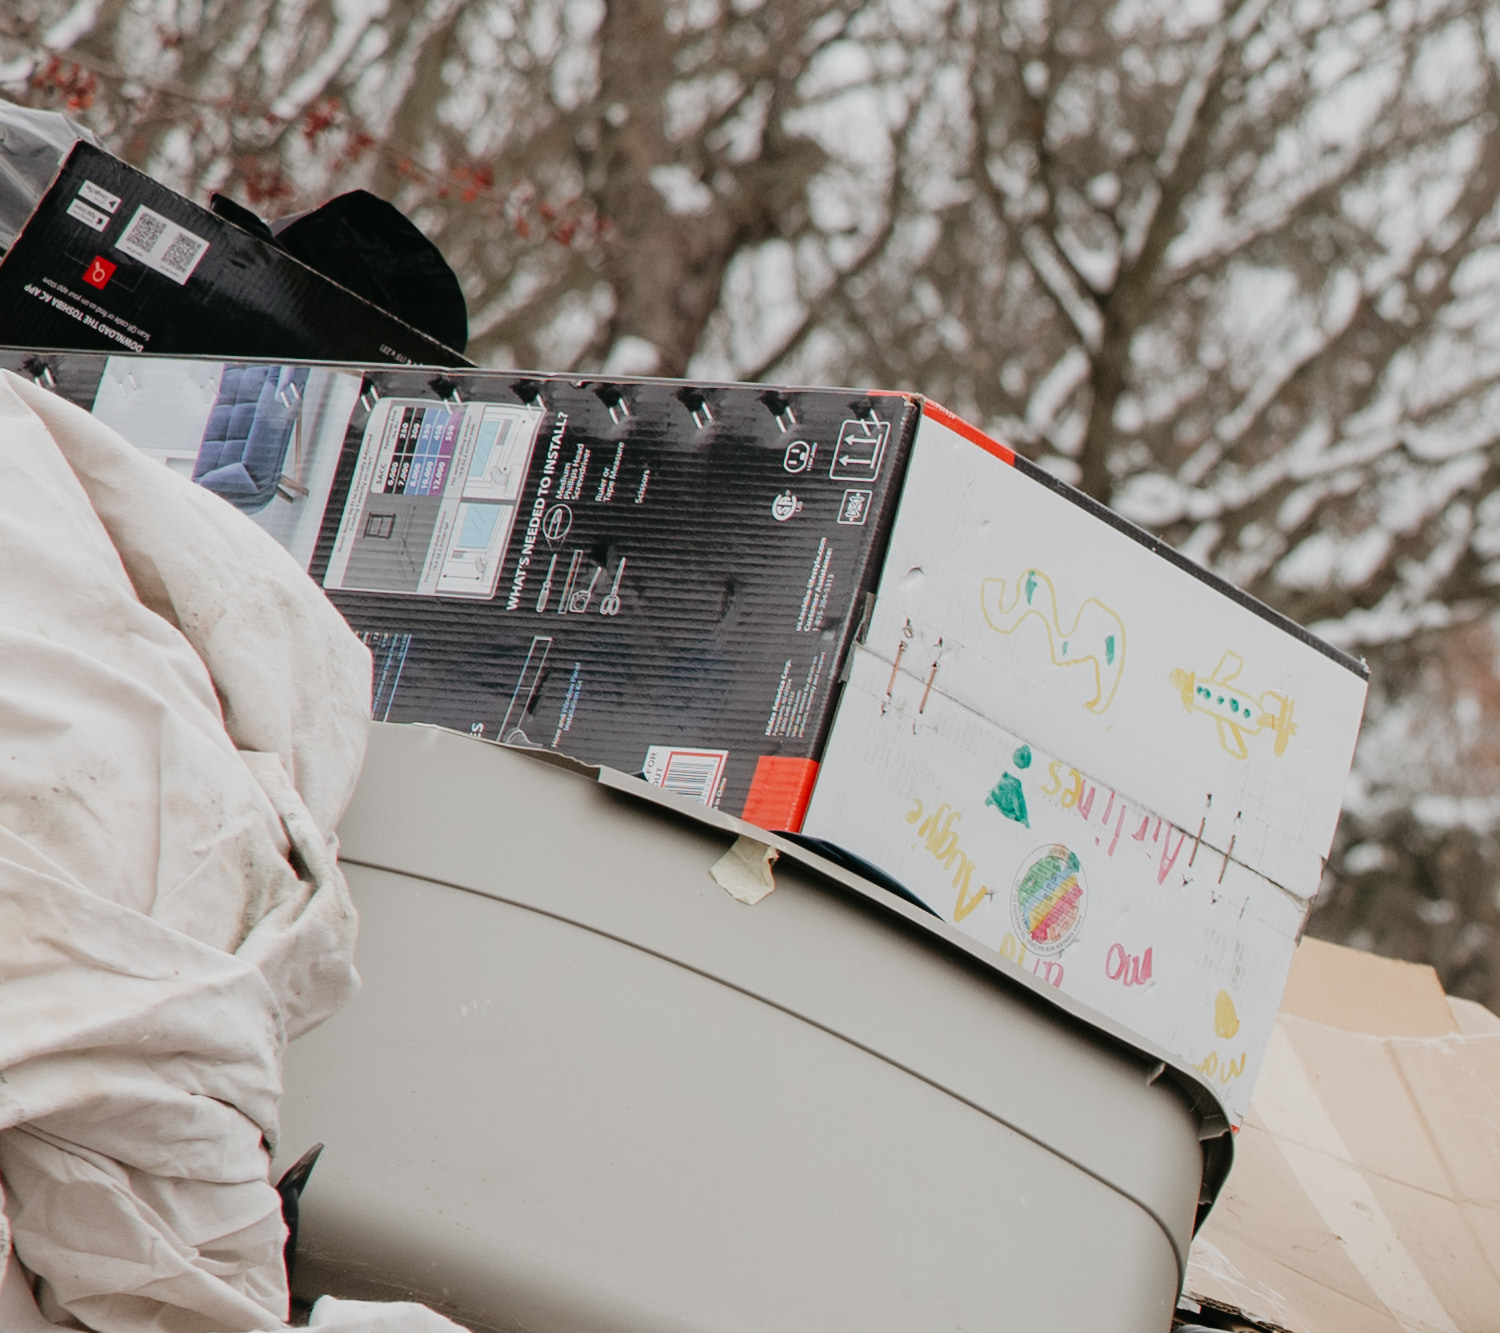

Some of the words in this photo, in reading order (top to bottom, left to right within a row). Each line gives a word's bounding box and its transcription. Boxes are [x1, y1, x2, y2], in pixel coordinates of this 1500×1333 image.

[23, 281, 41, 297] APP
[38, 290, 52, 303] AC
[50, 296, 84, 320] TOSHIBA
[82, 314, 100, 329] THE
[97, 322, 144, 353] DOWNLOAD
[543, 412, 569, 474] INSTALL?
[537, 476, 552, 498] TO
[556, 462, 571, 498] Medium
[564, 468, 579, 499] Phillips
[572, 443, 584, 466] Head
[572, 448, 591, 499] Screwdriver
[604, 480, 616, 501] Tape
[610, 441, 625, 478] Measure
[635, 468, 651, 503] Scissors
[595, 478, 608, 501] Ruler
[522, 498, 546, 553] NEEDED
[506, 556, 531, 611] WHAT'S
[804, 593, 820, 631] Customer
[766, 712, 776, 735] Midea
[773, 680, 786, 710] America
[782, 659, 793, 678] Corp.
